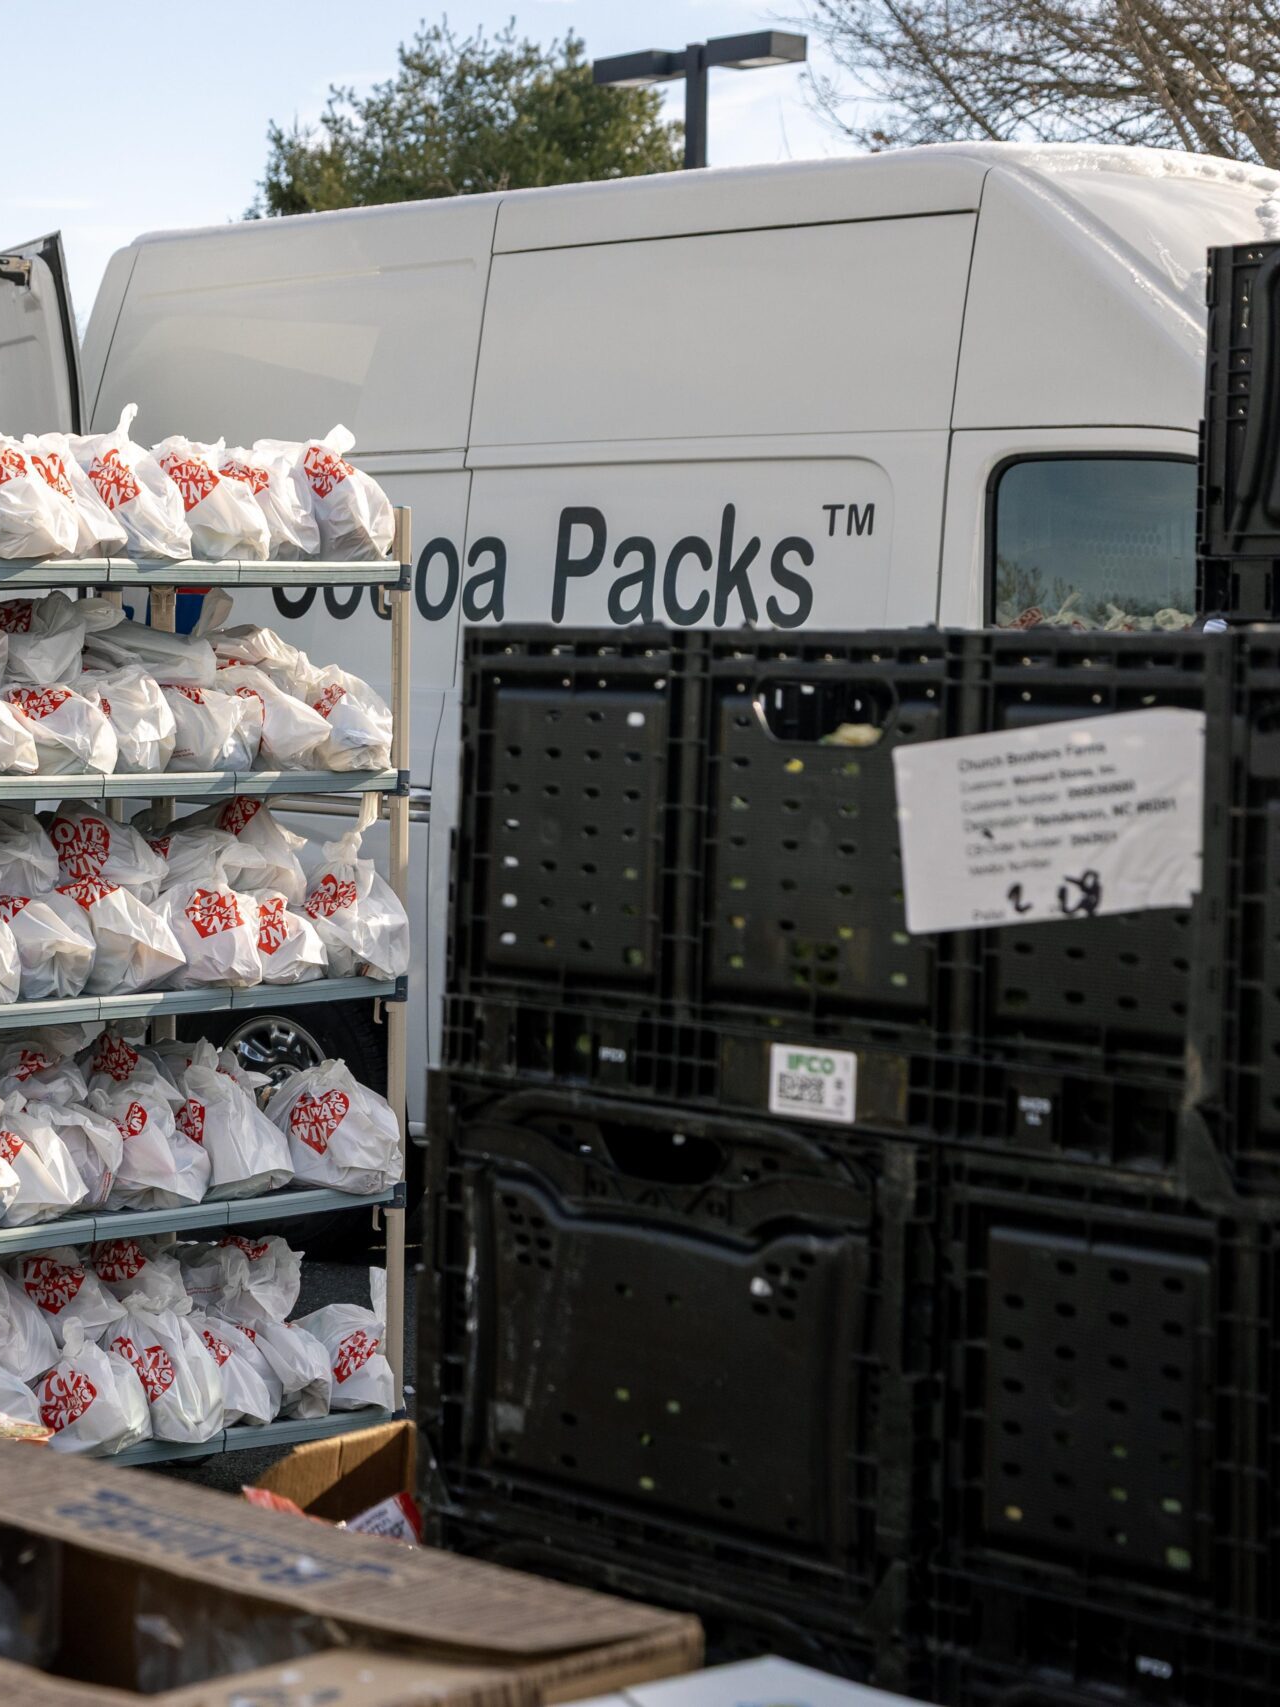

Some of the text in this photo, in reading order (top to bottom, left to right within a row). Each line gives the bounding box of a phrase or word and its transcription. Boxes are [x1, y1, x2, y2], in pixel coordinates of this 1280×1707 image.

[173, 465, 211, 480] ALWA
[551, 503, 815, 628] Packs
[822, 503, 875, 537] TM
[54, 823, 105, 844] OVE
[787, 1054, 836, 1075] IFCO
